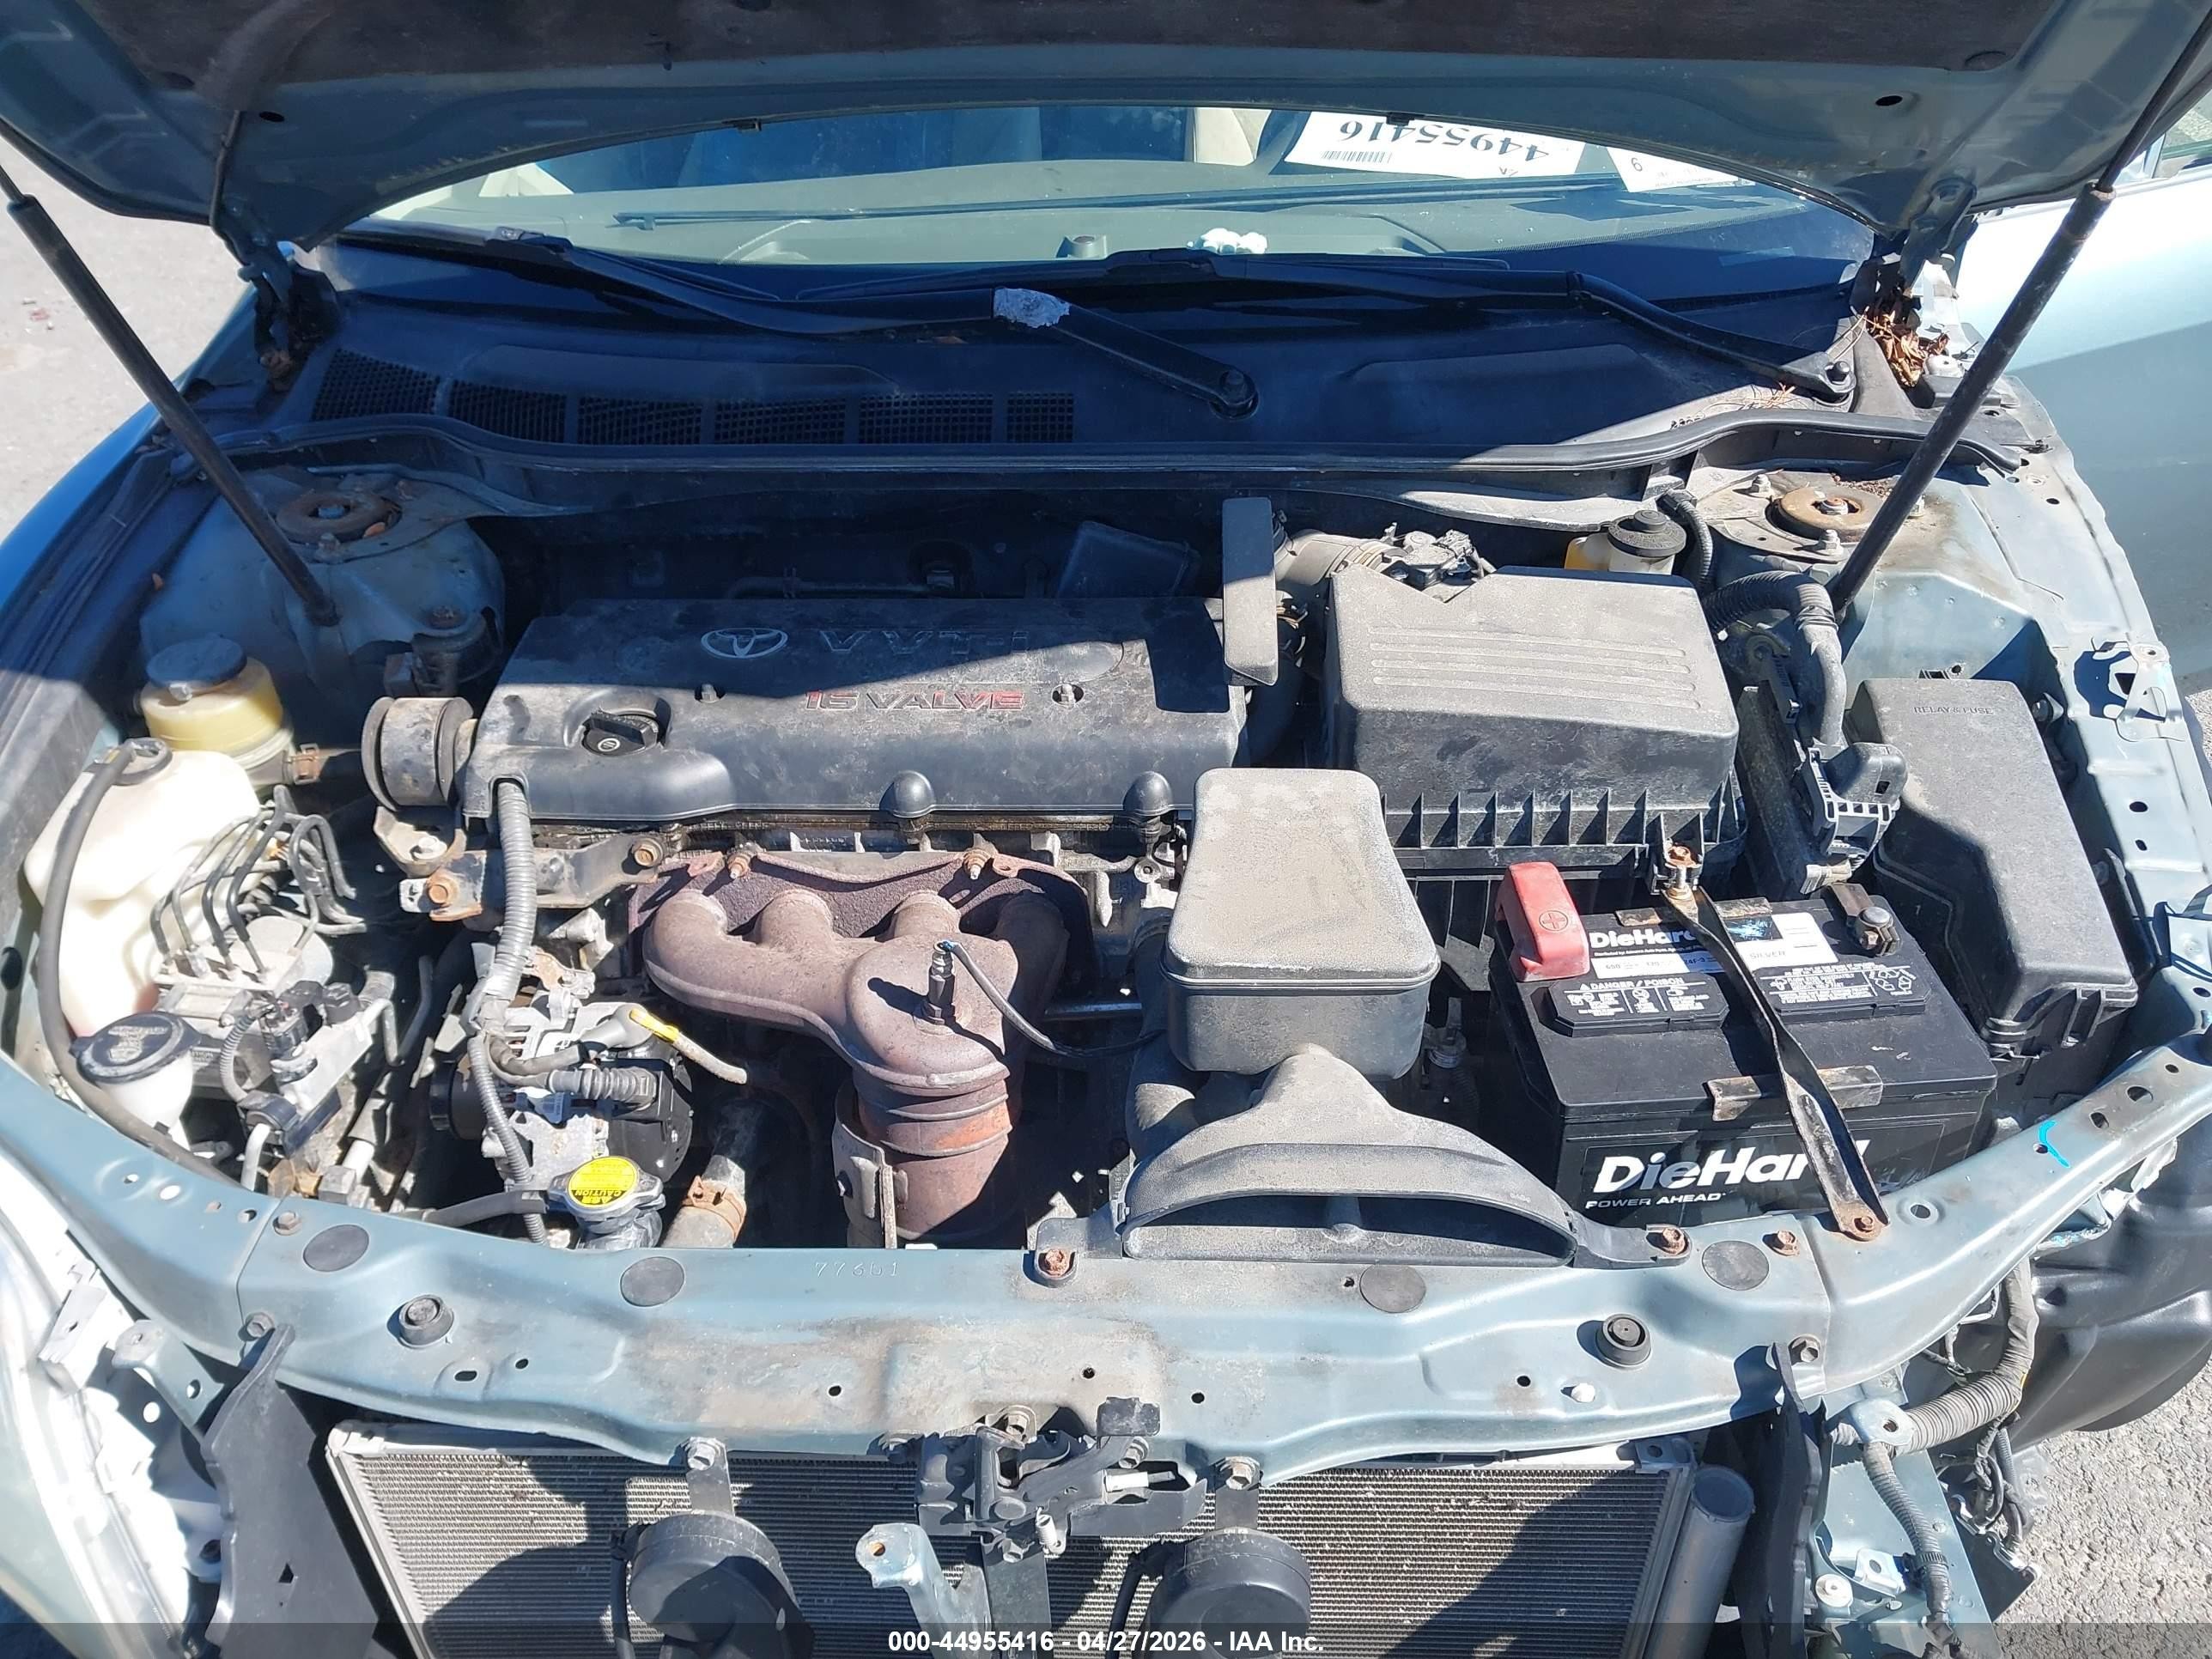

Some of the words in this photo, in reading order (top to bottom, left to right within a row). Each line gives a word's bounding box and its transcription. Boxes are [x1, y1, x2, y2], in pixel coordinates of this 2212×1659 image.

[1338, 120, 1550, 162] 44955416
[804, 690, 860, 710] 16
[866, 690, 1025, 711] VALVE
[1590, 981, 1635, 990] DANGER
[1644, 977, 1686, 987] POISON
[1593, 1140, 1870, 1193] DieHar
[1586, 1198, 1650, 1209] POWER
[1656, 1193, 1723, 1205] AHEAD
